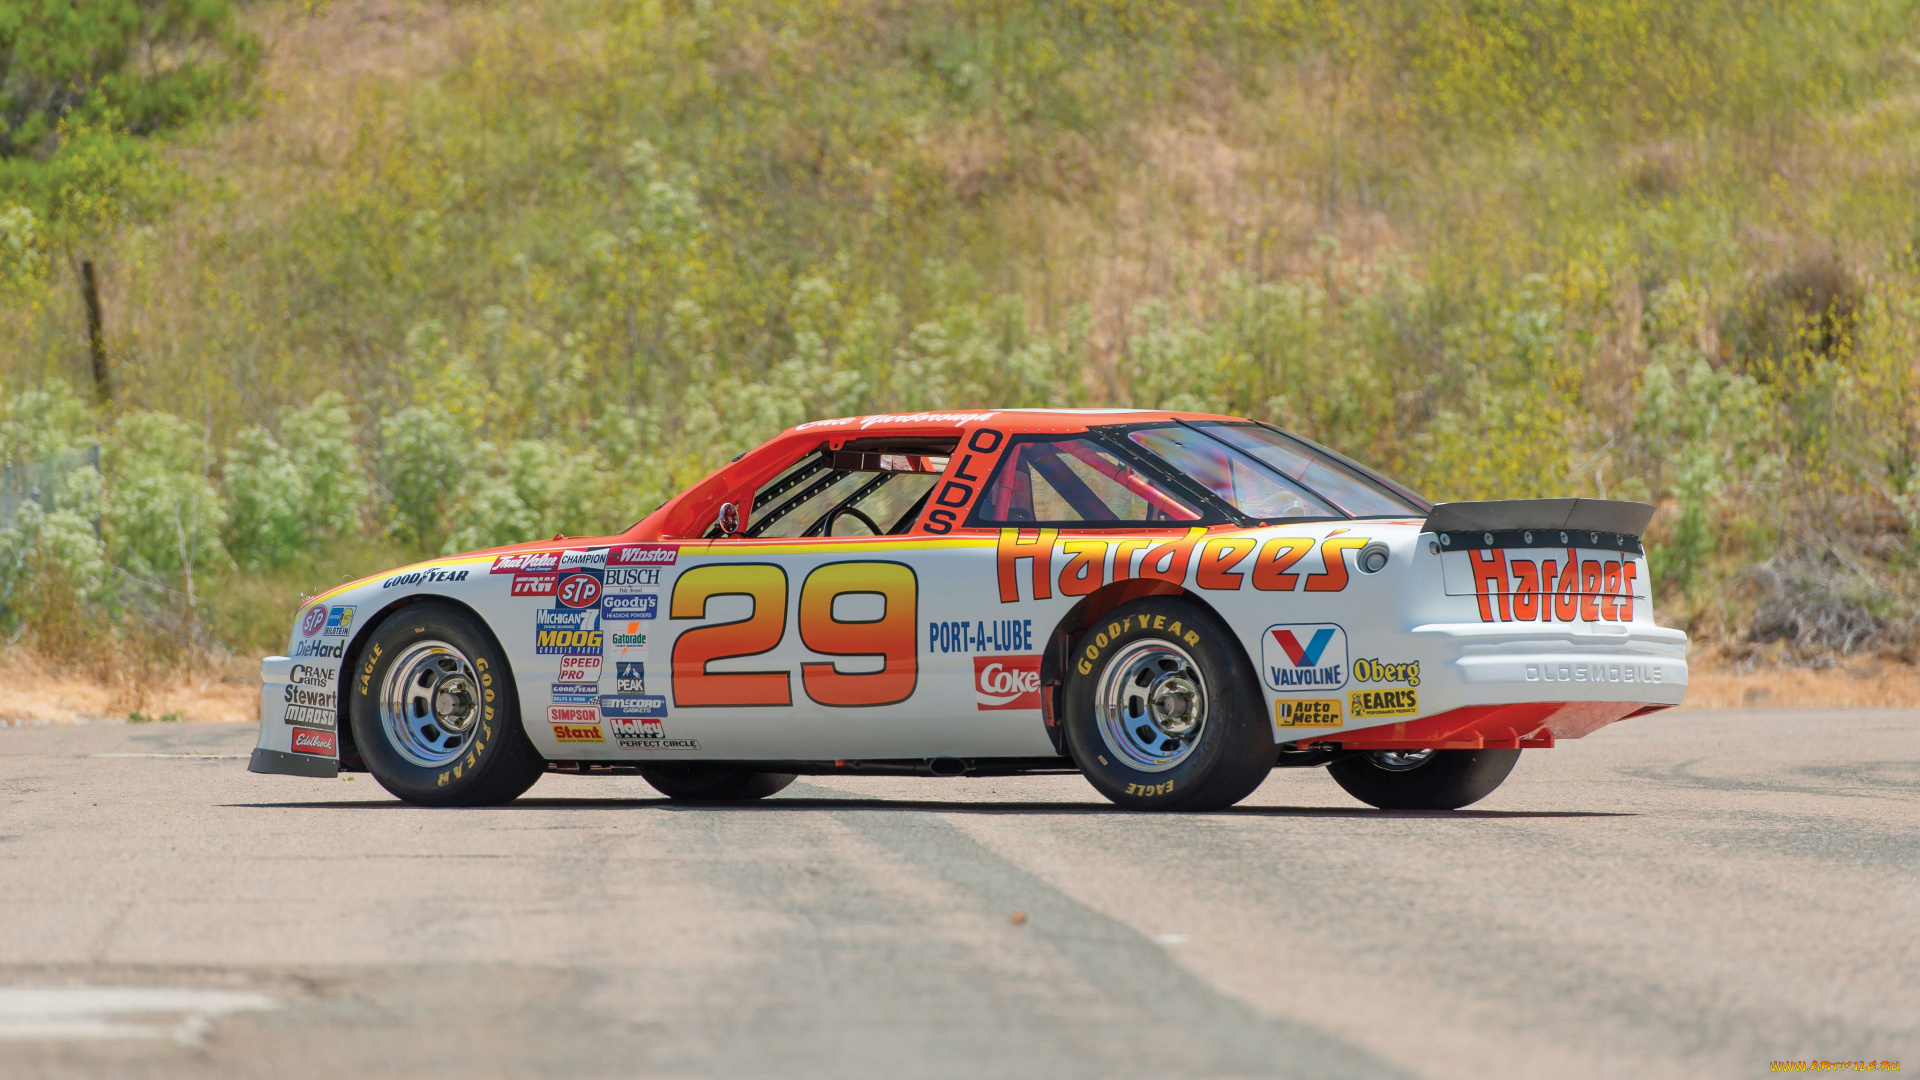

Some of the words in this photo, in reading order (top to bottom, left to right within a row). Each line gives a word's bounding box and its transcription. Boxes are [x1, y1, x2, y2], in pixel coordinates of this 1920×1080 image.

[923, 428, 1003, 535] OLDS
[561, 553, 606, 565] CHAMPION
[620, 548, 677, 562] Winston
[997, 527, 1371, 603] Hardee's
[383, 568, 469, 589] GOODYEAR
[514, 576, 556, 593] TRW
[604, 569, 661, 586] BUSCH
[562, 577, 597, 603] STP
[603, 596, 656, 611] Goody's
[304, 608, 324, 633] STP
[536, 630, 603, 647] MOOG
[612, 633, 647, 644] Gatorade
[669, 559, 919, 708] 29
[929, 619, 1032, 653] PORT-A-LUBE
[539, 646, 572, 654] CHASSIS
[576, 646, 601, 654] PARTS
[1077, 614, 1200, 675] GOODYEAR
[359, 643, 383, 696] EAGLE
[563, 658, 600, 668] SPEED
[1353, 657, 1420, 687] Oberg
[560, 670, 585, 680] PRO
[980, 663, 1040, 696] Coke
[1270, 664, 1342, 686] VALVOLINE
[1524, 664, 1662, 685] OLDSMOBILE
[553, 685, 597, 693] GOODYEAR
[617, 679, 644, 691] PEAK
[284, 683, 337, 708] Stewart
[1363, 690, 1416, 709] EARL'S
[285, 705, 336, 726] MOROSO
[551, 709, 596, 721] SIMPSON
[1295, 701, 1330, 712] Auto
[437, 657, 495, 787] GOODYEAR
[1293, 712, 1339, 723] Meter
[553, 725, 602, 739] Stant
[611, 719, 664, 738] Holley
[295, 733, 333, 750] Edelbrock
[619, 739, 661, 747] PERFECT
[664, 739, 697, 747] CIRCLE
[1125, 779, 1175, 797] EAGLE
